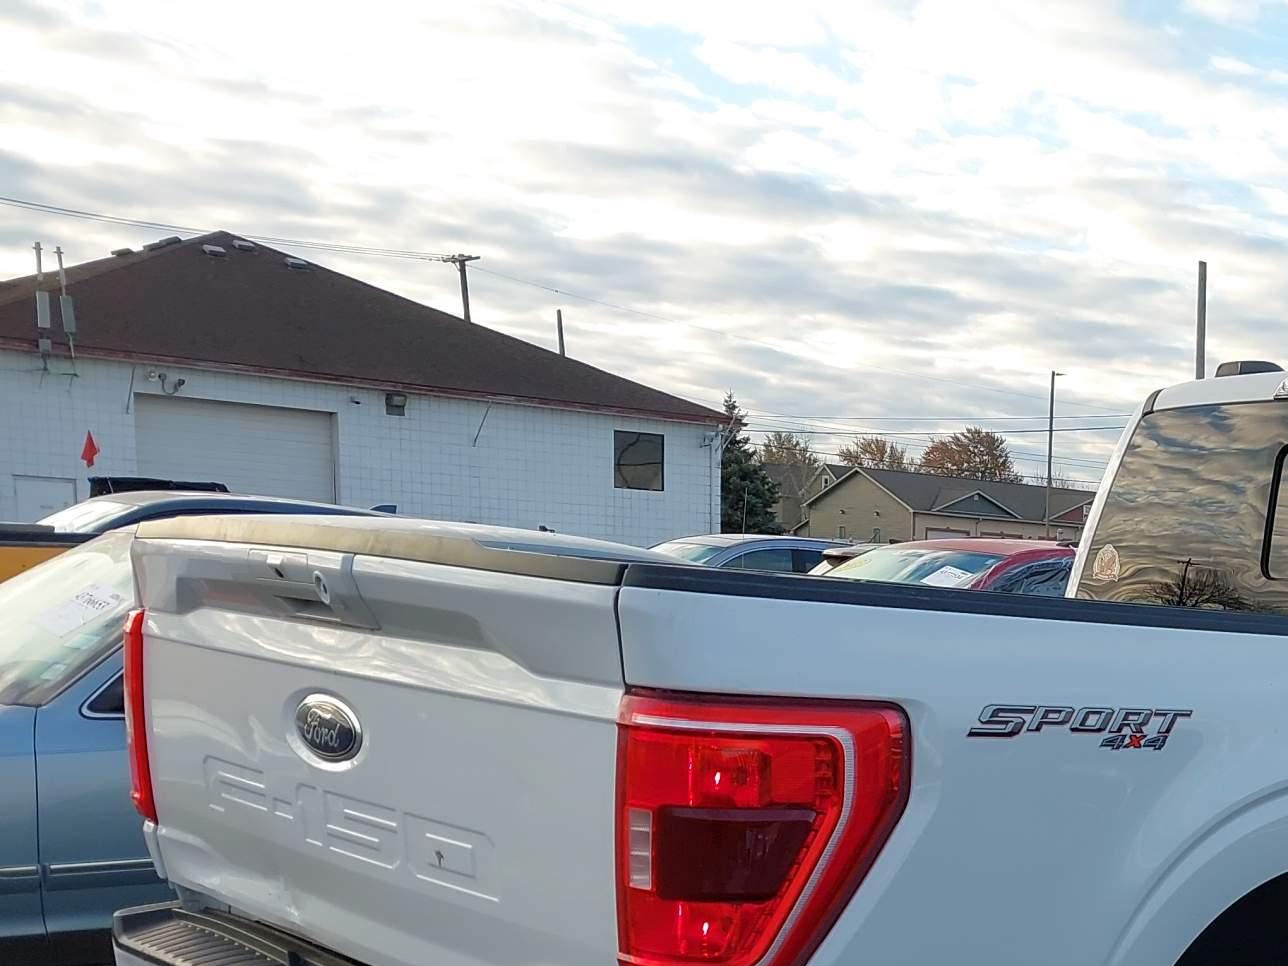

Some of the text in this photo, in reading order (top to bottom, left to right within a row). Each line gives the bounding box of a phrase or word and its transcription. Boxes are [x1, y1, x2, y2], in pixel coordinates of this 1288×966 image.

[304, 709, 342, 749] Ford
[966, 703, 1194, 738] SPORT
[202, 754, 500, 903] F-150
